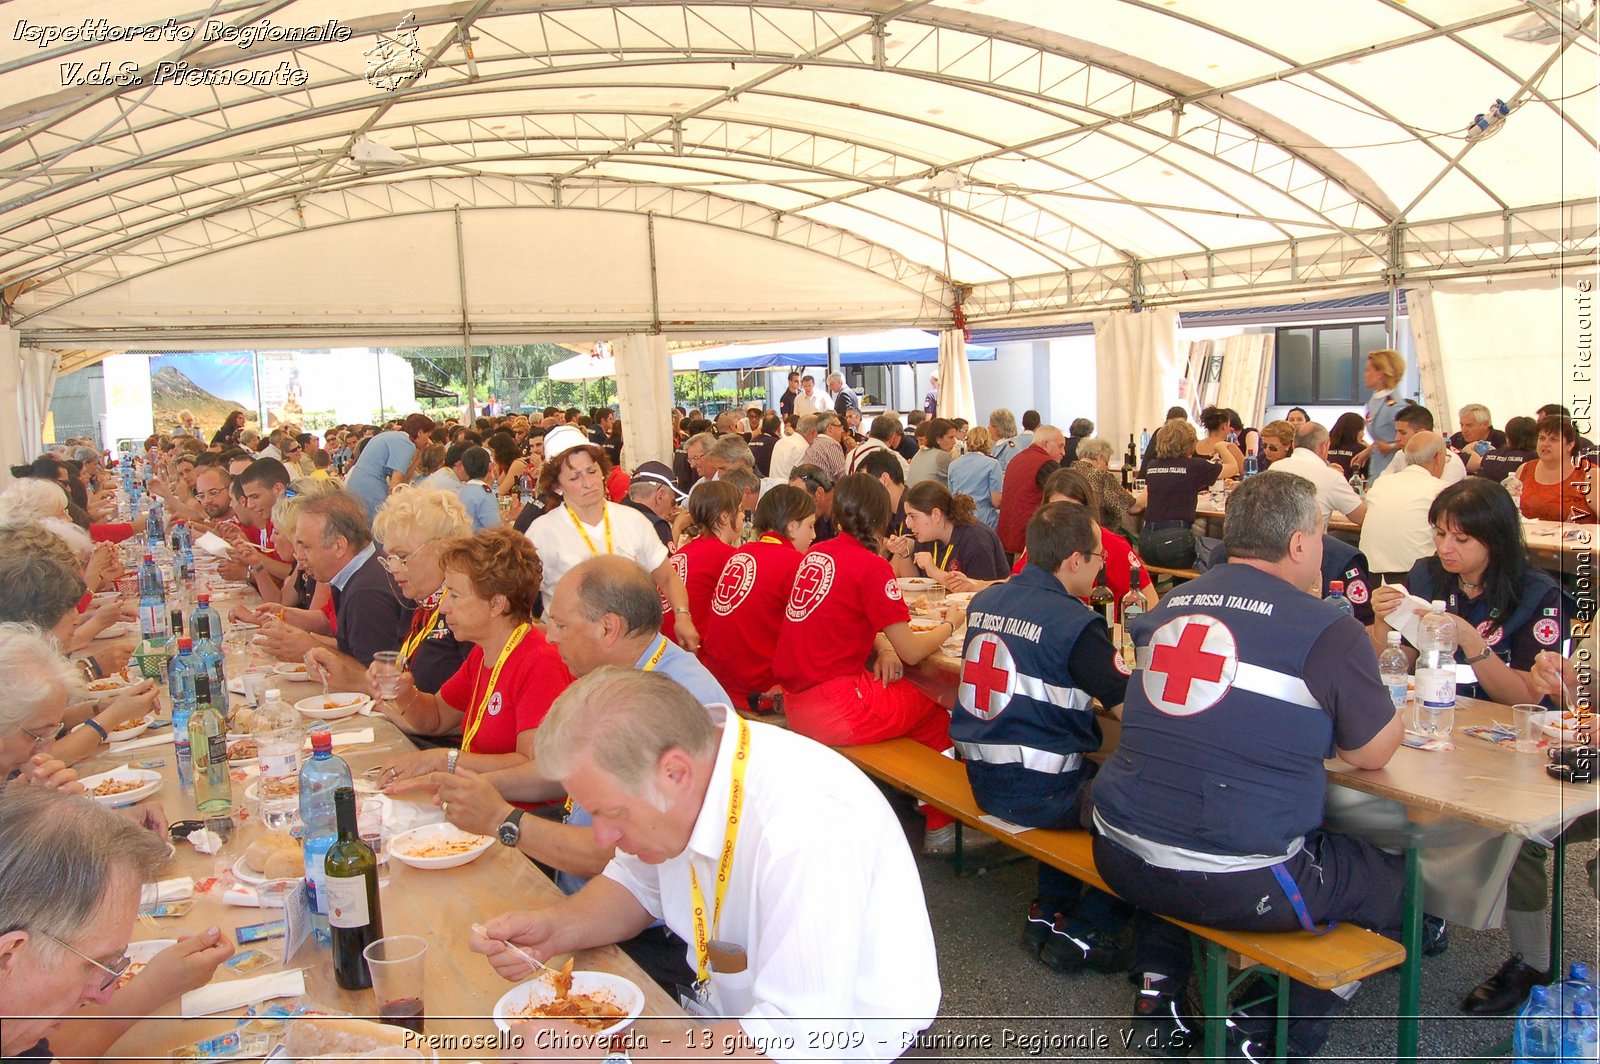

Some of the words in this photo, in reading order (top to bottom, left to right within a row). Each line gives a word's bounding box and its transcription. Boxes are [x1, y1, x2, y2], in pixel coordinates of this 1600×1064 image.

[1167, 595, 1194, 608] CROCE
[1193, 594, 1224, 606] ROSSA
[1225, 595, 1274, 616] ITALIANA
[981, 613, 1005, 633] ROSSA
[1004, 617, 1043, 644] ITALIANA
[721, 840, 732, 873] FERNO
[697, 916, 706, 952] FERNO
